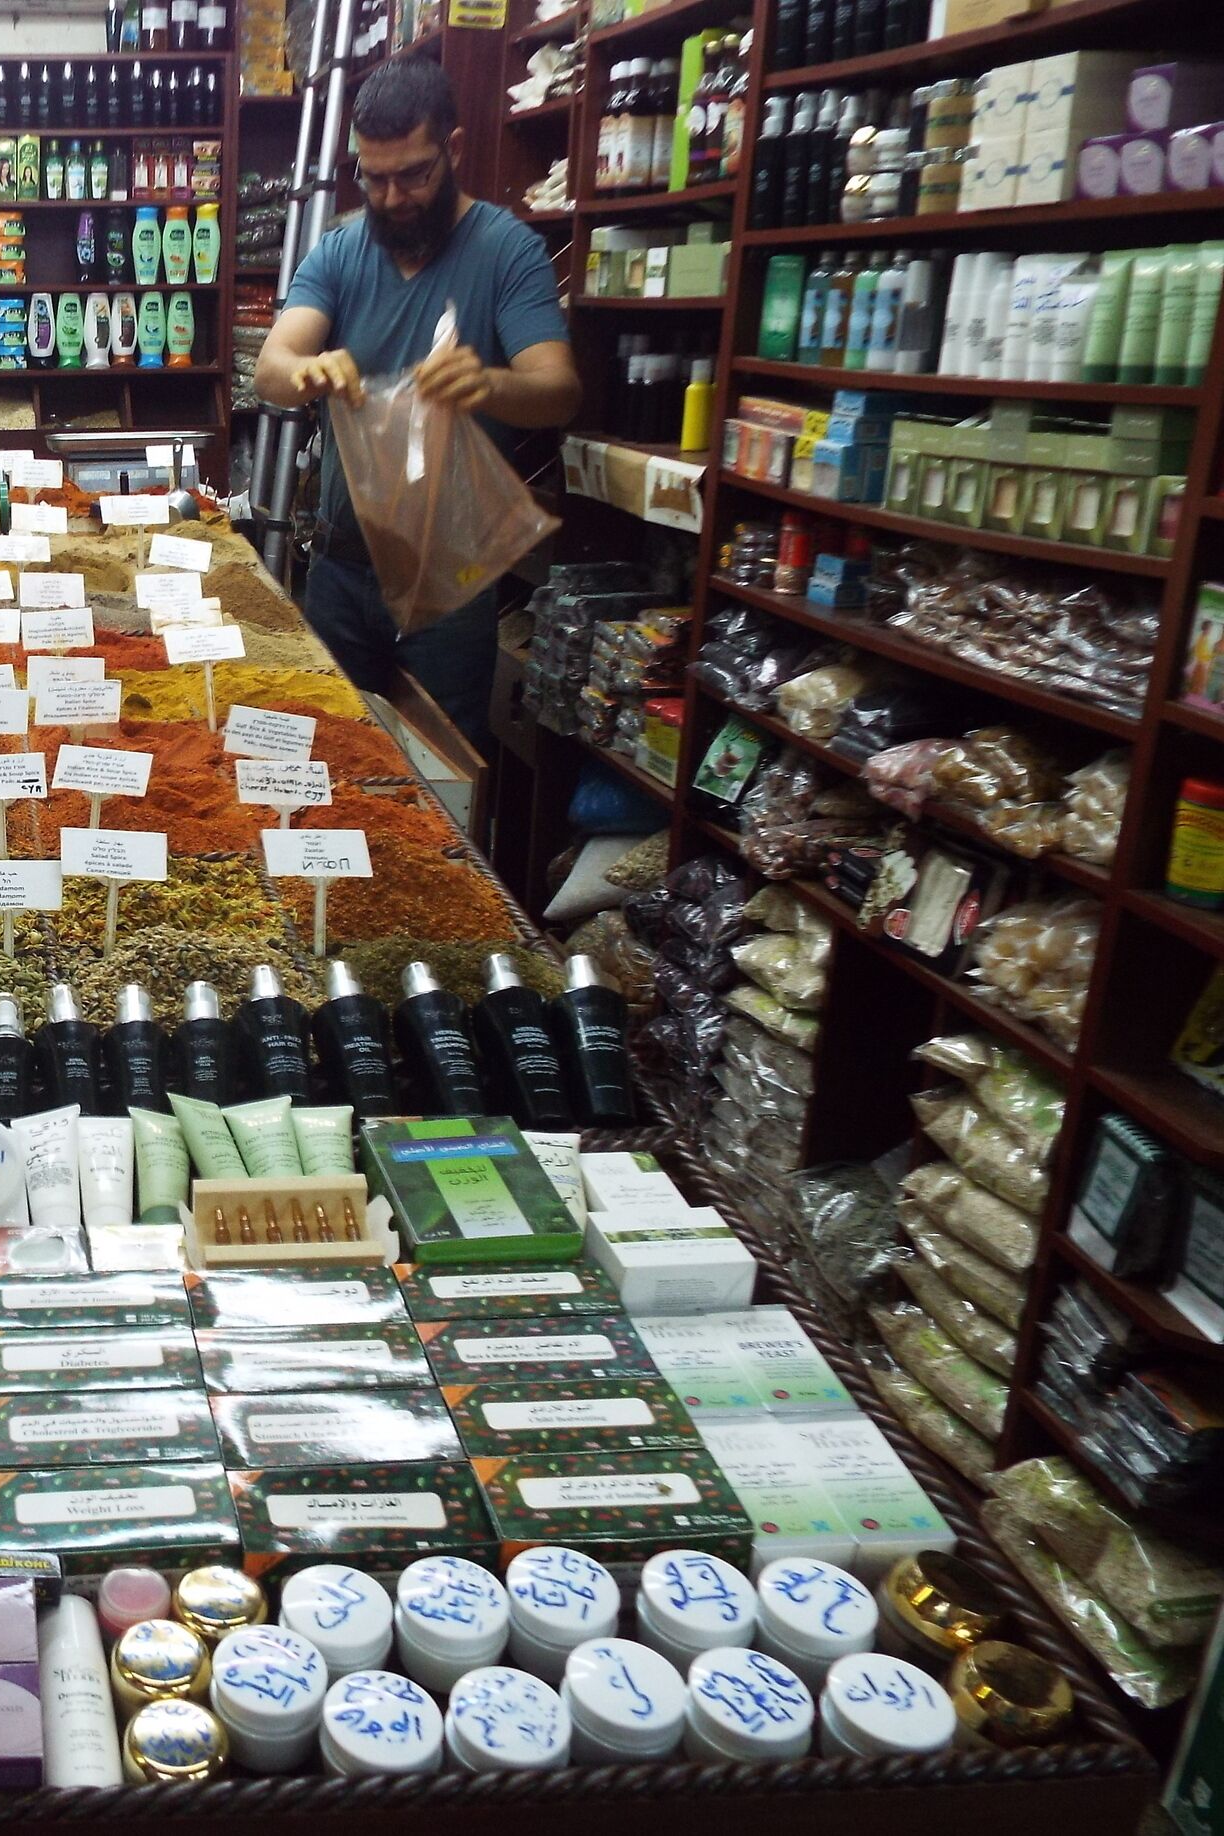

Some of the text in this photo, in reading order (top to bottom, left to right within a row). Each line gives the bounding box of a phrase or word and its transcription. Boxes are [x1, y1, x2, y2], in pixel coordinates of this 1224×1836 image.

[343, 1041, 383, 1050] TREATMENT
[738, 1339, 805, 1350] BREWER'S
[756, 1348, 798, 1358] YEAST
[60, 1358, 111, 1367] Diabetes
[66, 1504, 146, 1516] Weight Loss
